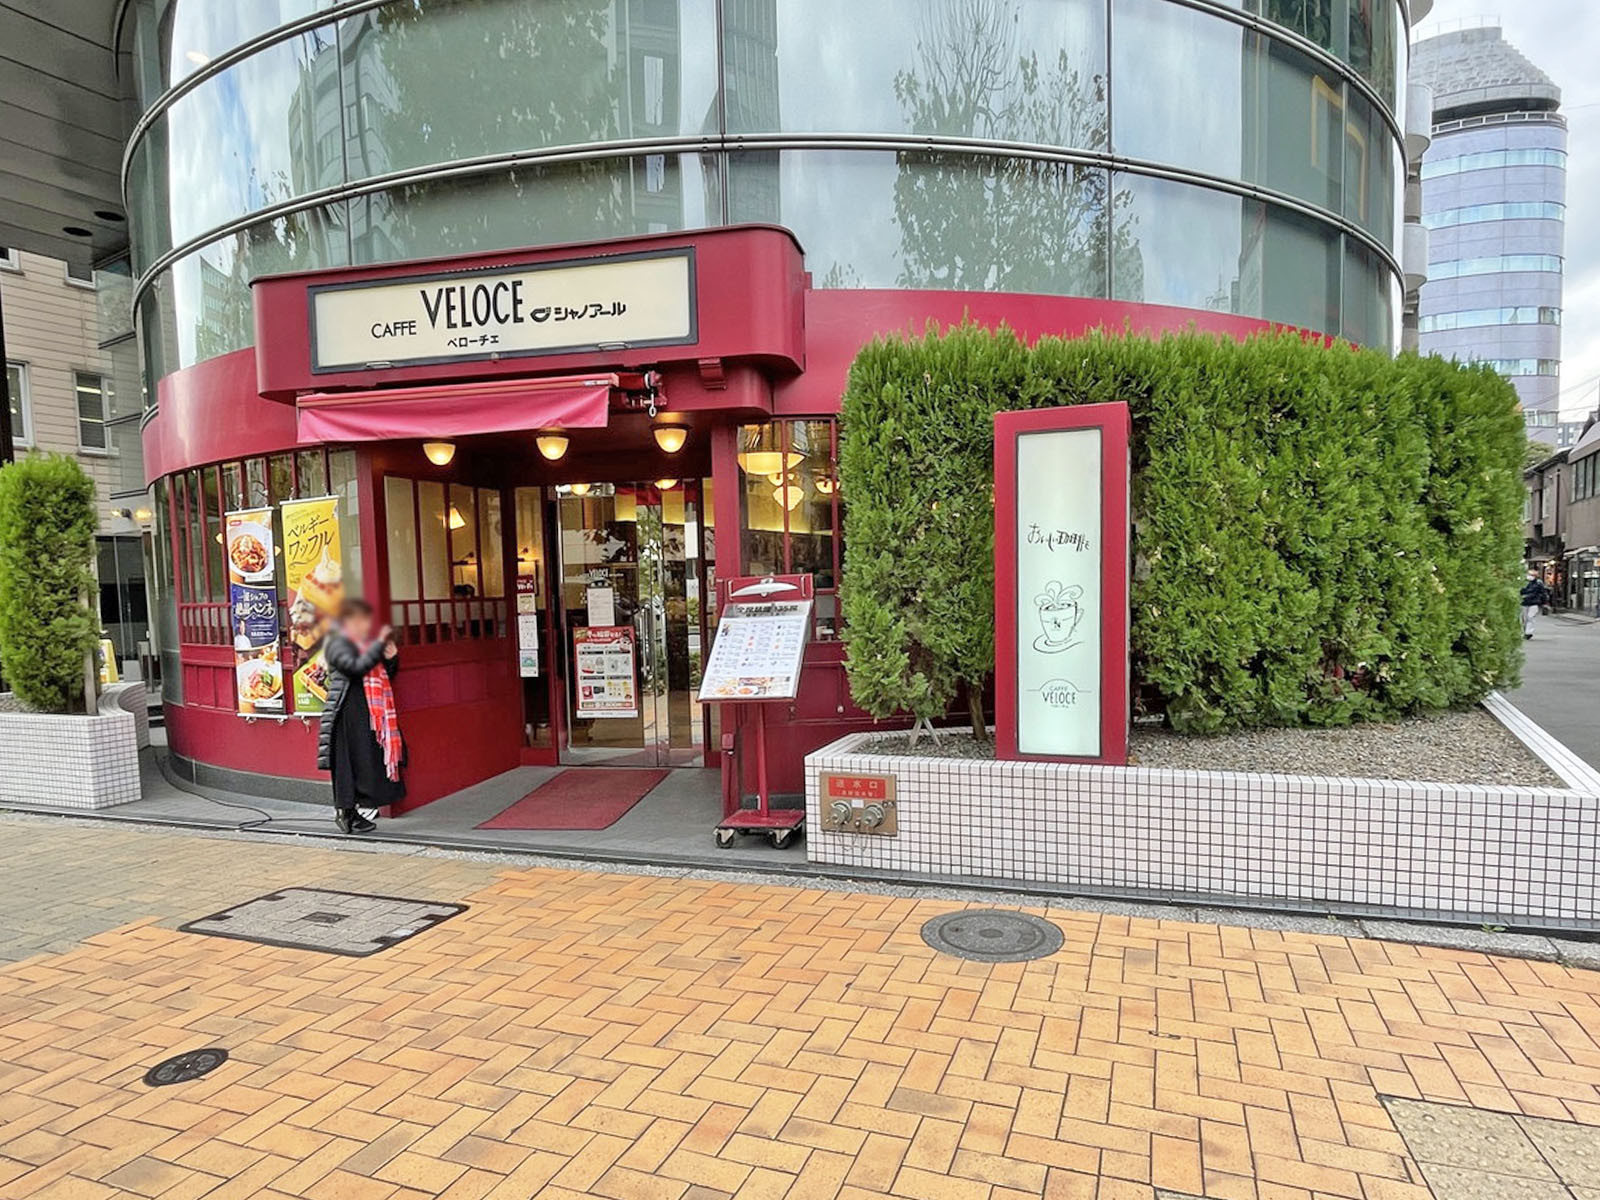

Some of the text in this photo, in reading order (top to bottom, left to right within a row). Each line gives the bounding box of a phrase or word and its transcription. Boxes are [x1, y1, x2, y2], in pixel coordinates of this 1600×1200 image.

[371, 280, 524, 339] CAFFE VELOCE
[554, 302, 626, 321] シャノアール
[287, 514, 329, 537] ベルギー
[288, 530, 335, 564] ワッフル
[1042, 691, 1076, 705] VELOCE
